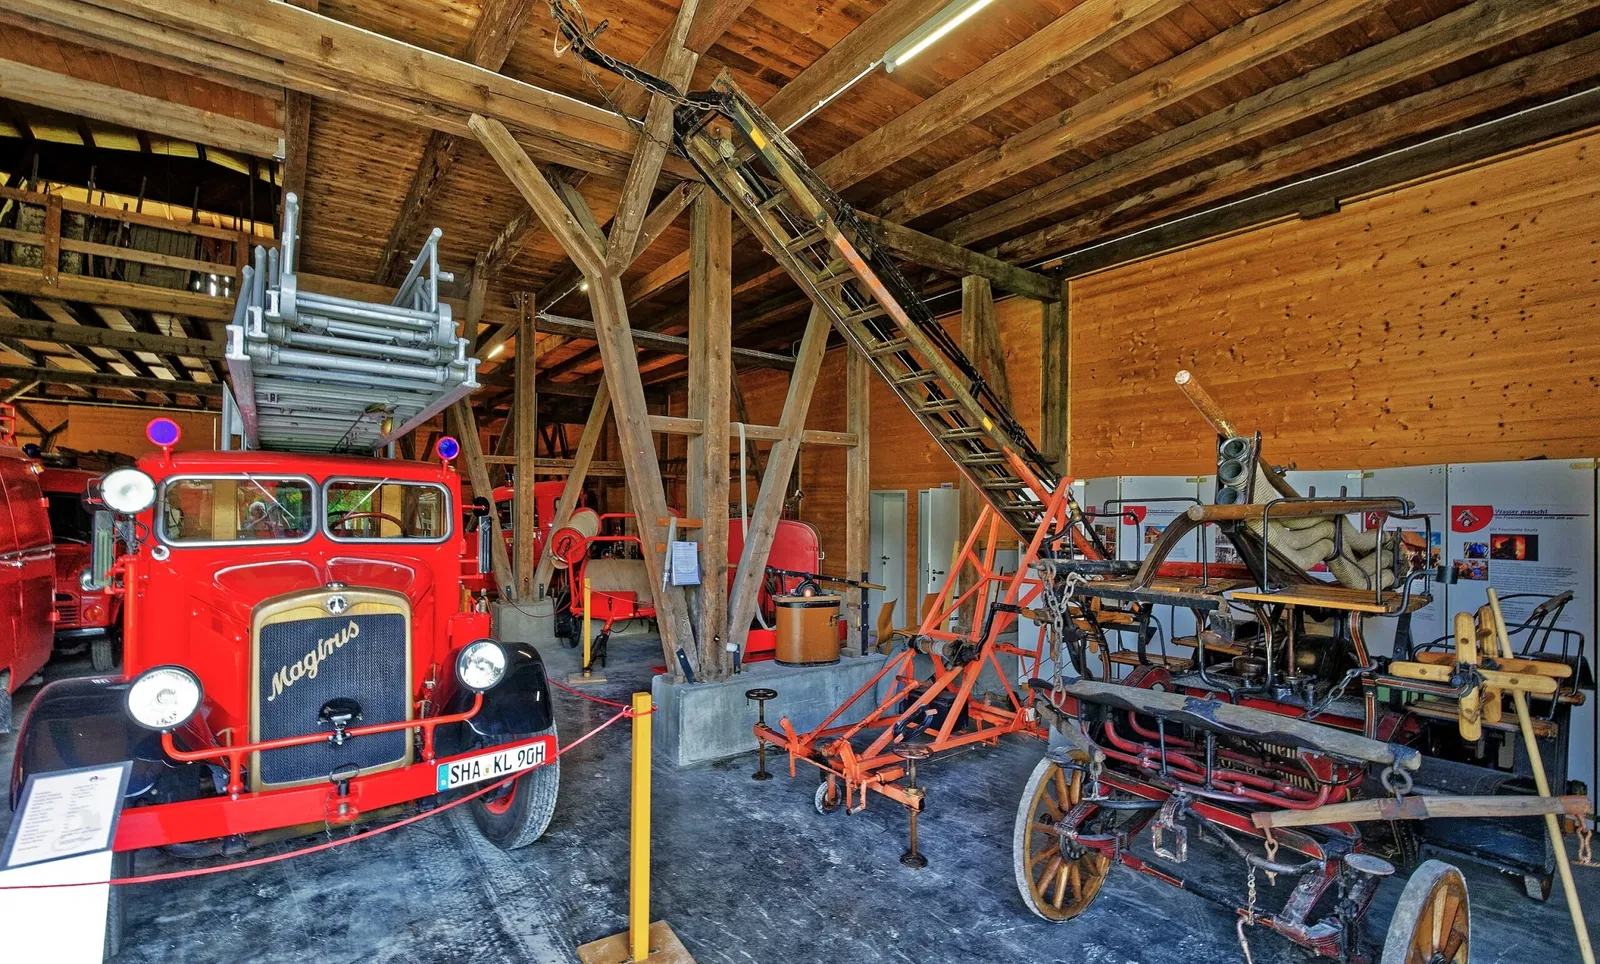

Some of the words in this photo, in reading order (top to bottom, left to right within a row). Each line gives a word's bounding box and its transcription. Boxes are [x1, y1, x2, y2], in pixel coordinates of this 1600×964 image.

[267, 620, 359, 701] Magirus
[450, 760, 481, 785] SHA
[493, 753, 512, 774] KL
